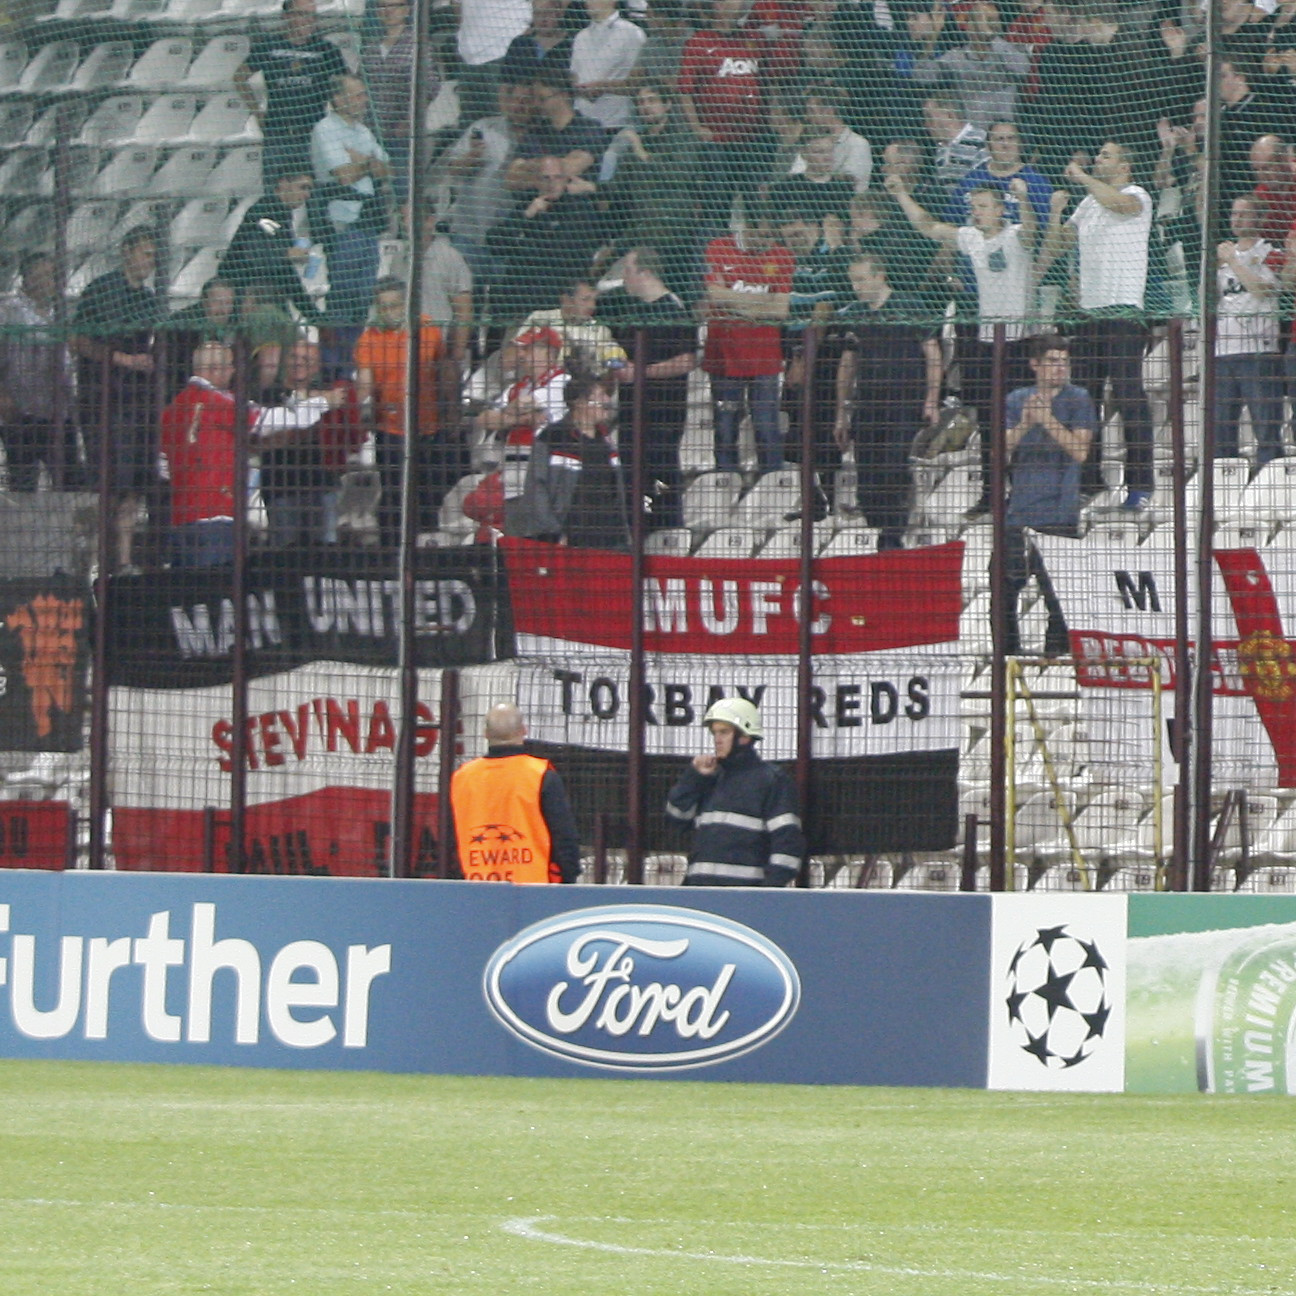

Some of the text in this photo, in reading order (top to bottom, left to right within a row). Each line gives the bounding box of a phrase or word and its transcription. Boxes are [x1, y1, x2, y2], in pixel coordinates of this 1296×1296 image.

[171, 589, 281, 658] MAN
[644, 578, 832, 635] MUFC
[0, 902, 392, 1049] urther
[546, 930, 737, 1039] Ford
